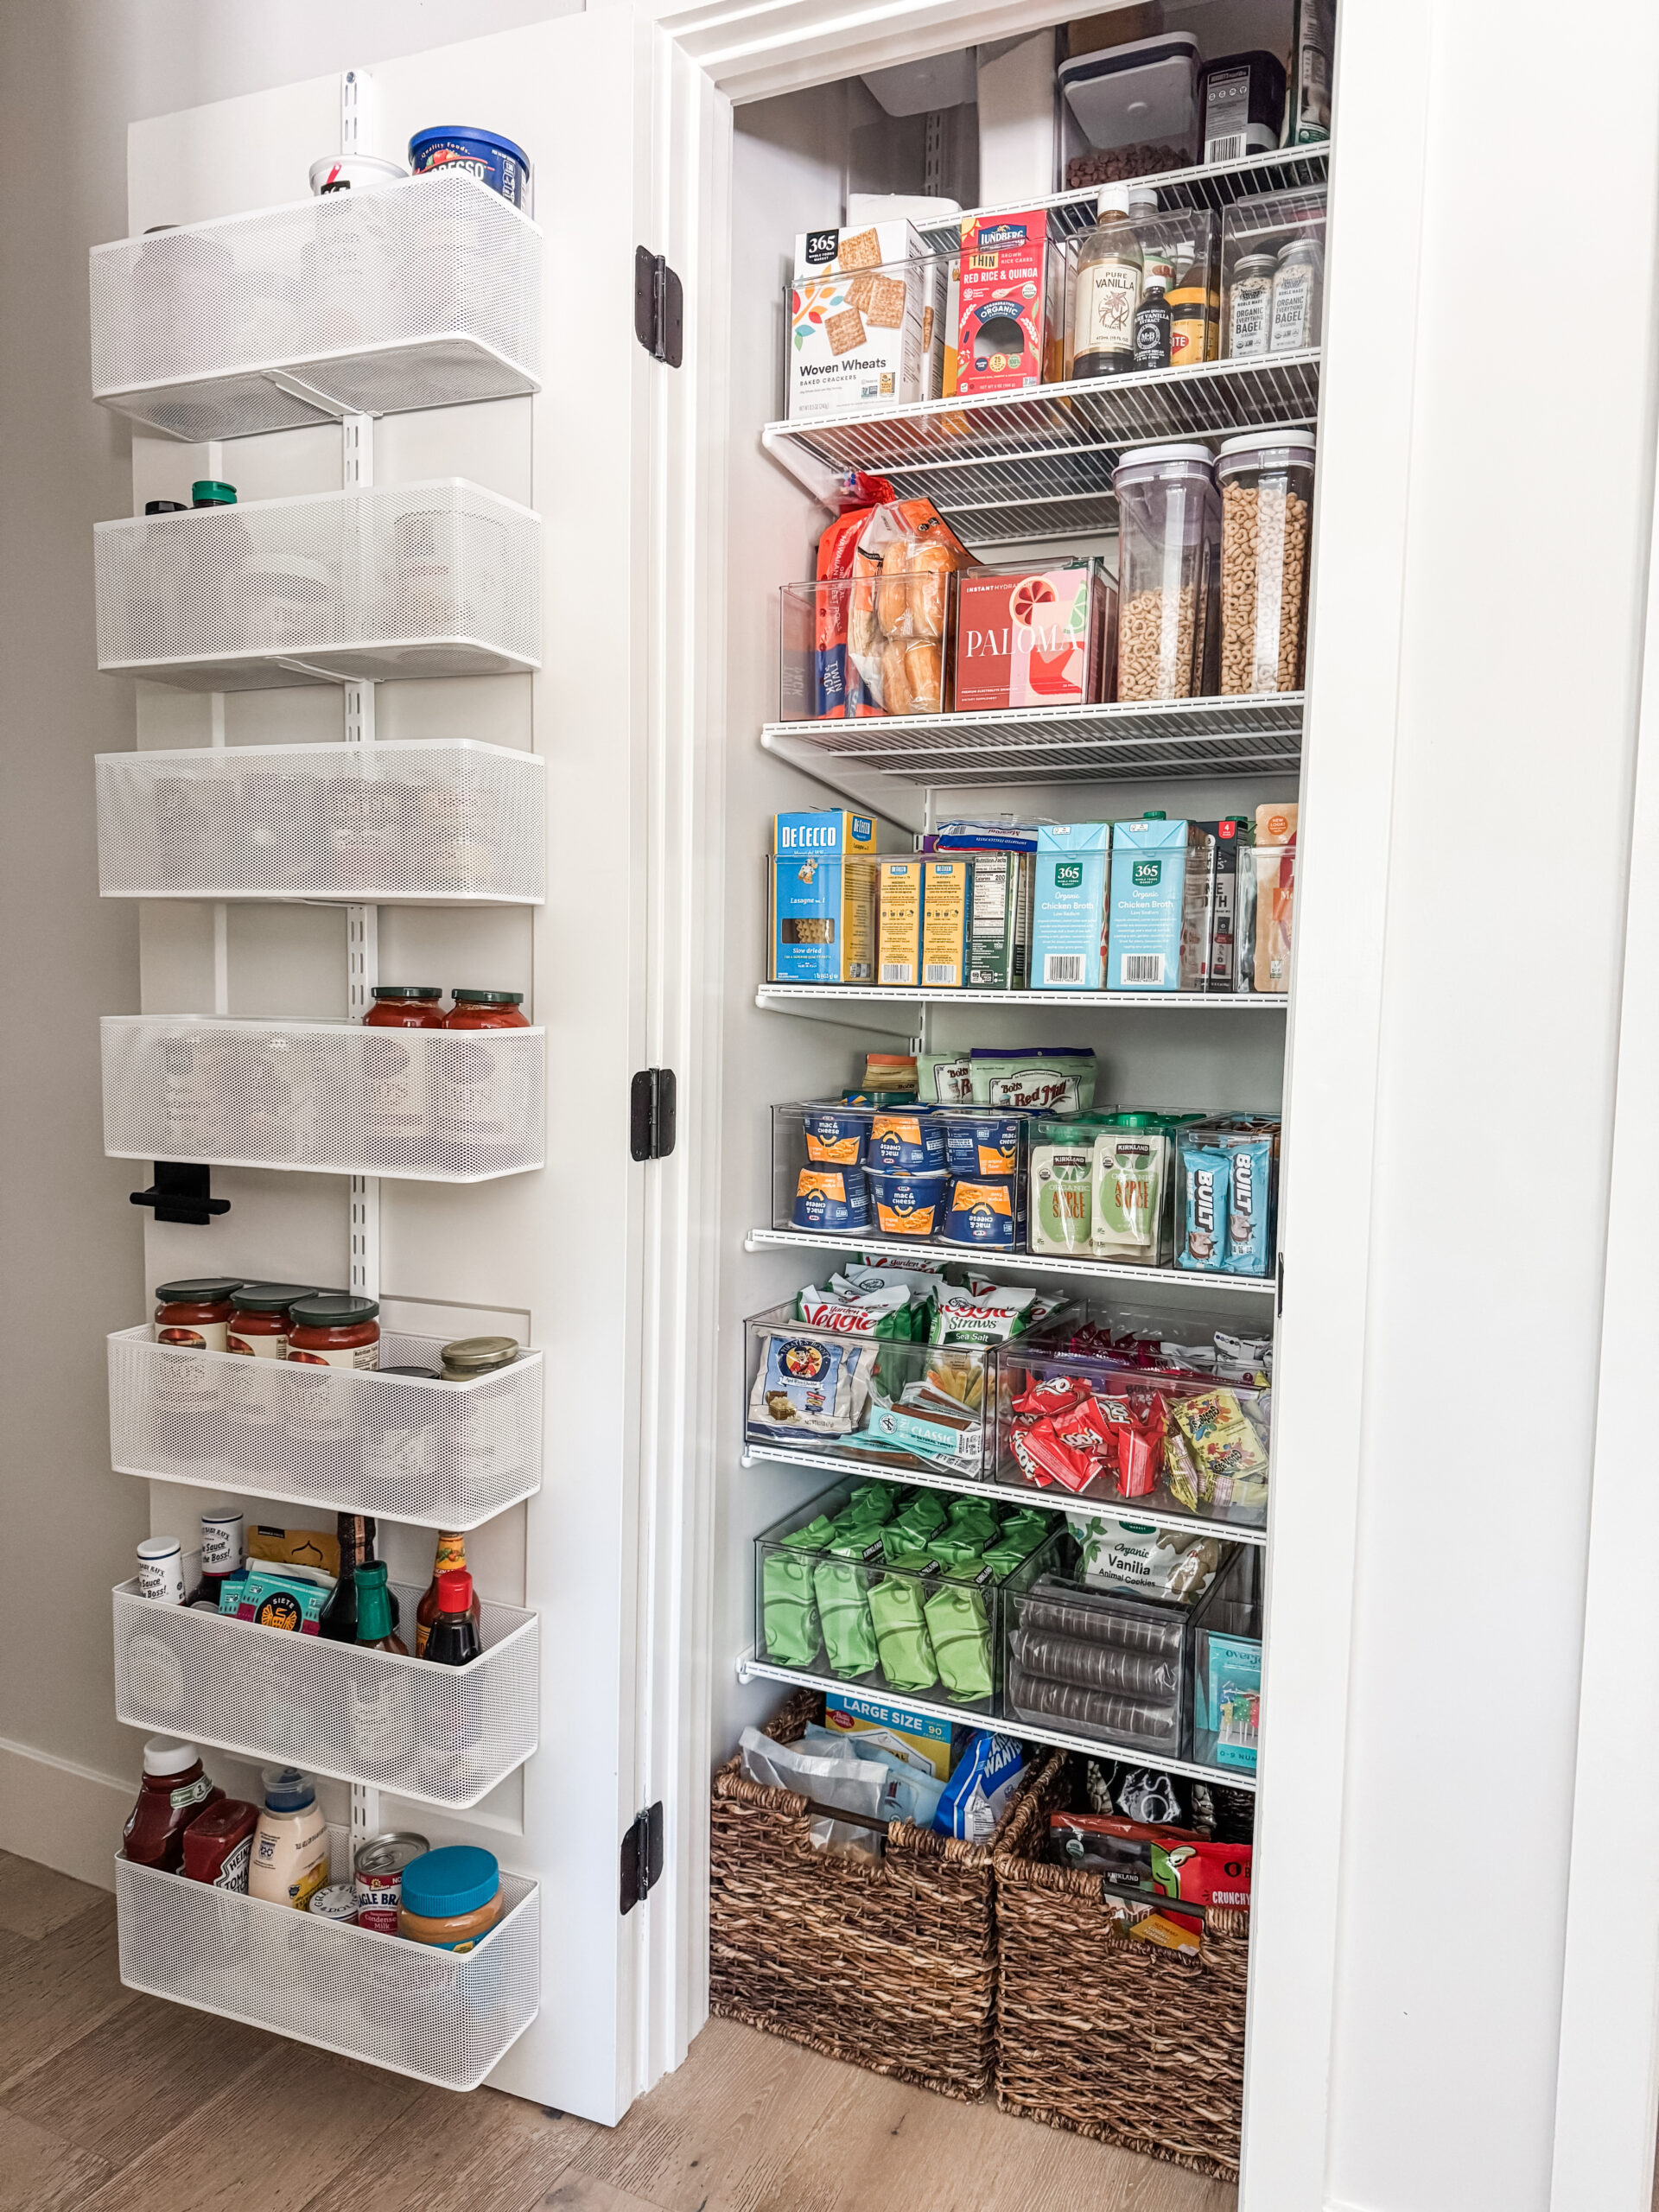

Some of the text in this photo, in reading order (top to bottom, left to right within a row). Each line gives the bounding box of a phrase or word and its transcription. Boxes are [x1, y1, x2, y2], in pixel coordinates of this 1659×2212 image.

[421, 143, 444, 158] Quality
[808, 235, 836, 253] 365
[972, 254, 995, 267] THIN
[963, 267, 1039, 284] RED RICE & QUINOA
[1096, 278, 1135, 291] VANILLA
[1276, 296, 1305, 307] ORGANIC
[980, 305, 1019, 318] ORGANIC
[1236, 307, 1264, 318] ORGANIC
[1276, 304, 1303, 313] EVERYTHING
[1236, 315, 1264, 323] EVERYTHING
[1275, 311, 1302, 324] BAGEL
[1236, 321, 1262, 334] BAGEL
[799, 358, 887, 377] Woven Wheats
[822, 374, 857, 384] CRACKERS
[833, 535, 847, 576] HAWAIIAN
[966, 585, 994, 594] INSTANT
[965, 624, 1080, 658] PALOMA
[829, 660, 843, 693] TWIN
[798, 826, 836, 848] CECCO
[1057, 867, 1080, 879] 365
[1135, 863, 1158, 877] 365
[1054, 891, 1080, 900] Organic
[1132, 889, 1159, 899] Organic
[1117, 900, 1150, 909] Chicken
[947, 1067, 969, 1078] Bob's
[1001, 1080, 1067, 1107] Bob's Red Mill
[1117, 1143, 1149, 1152] KIRKLAND
[1115, 1181, 1149, 1194] APPLE
[1235, 1154, 1252, 1216] BUILT
[1196, 1170, 1214, 1233] BUILT
[891, 1258, 919, 1268] garden
[830, 1306, 860, 1315] garden
[804, 1304, 877, 1332] Veggie
[950, 1316, 997, 1330] Straws
[971, 1333, 989, 1343] Salt
[912, 1426, 955, 1444] CLASSIC
[1213, 1449, 1243, 1472] Gushers
[207, 1541, 226, 1552] Sauce
[863, 1541, 883, 1559] KIRKLAND
[1114, 1543, 1149, 1559] Organic
[211, 1548, 231, 1562] Boss!
[921, 1561, 939, 1576] RKLAND
[976, 1566, 993, 1584] KIRKLAND
[142, 1578, 161, 1588] Sauce
[1098, 1567, 1155, 1586] Animal Cookies
[147, 1586, 167, 1599] Boss!
[272, 1598, 295, 1609] SIETE
[843, 1697, 923, 1731] LARGE SIZE
[928, 1726, 942, 1736] 90
[314, 1886, 334, 1908] GREY
[359, 1893, 378, 1908] AGLE
[365, 1914, 397, 1923] Condense
